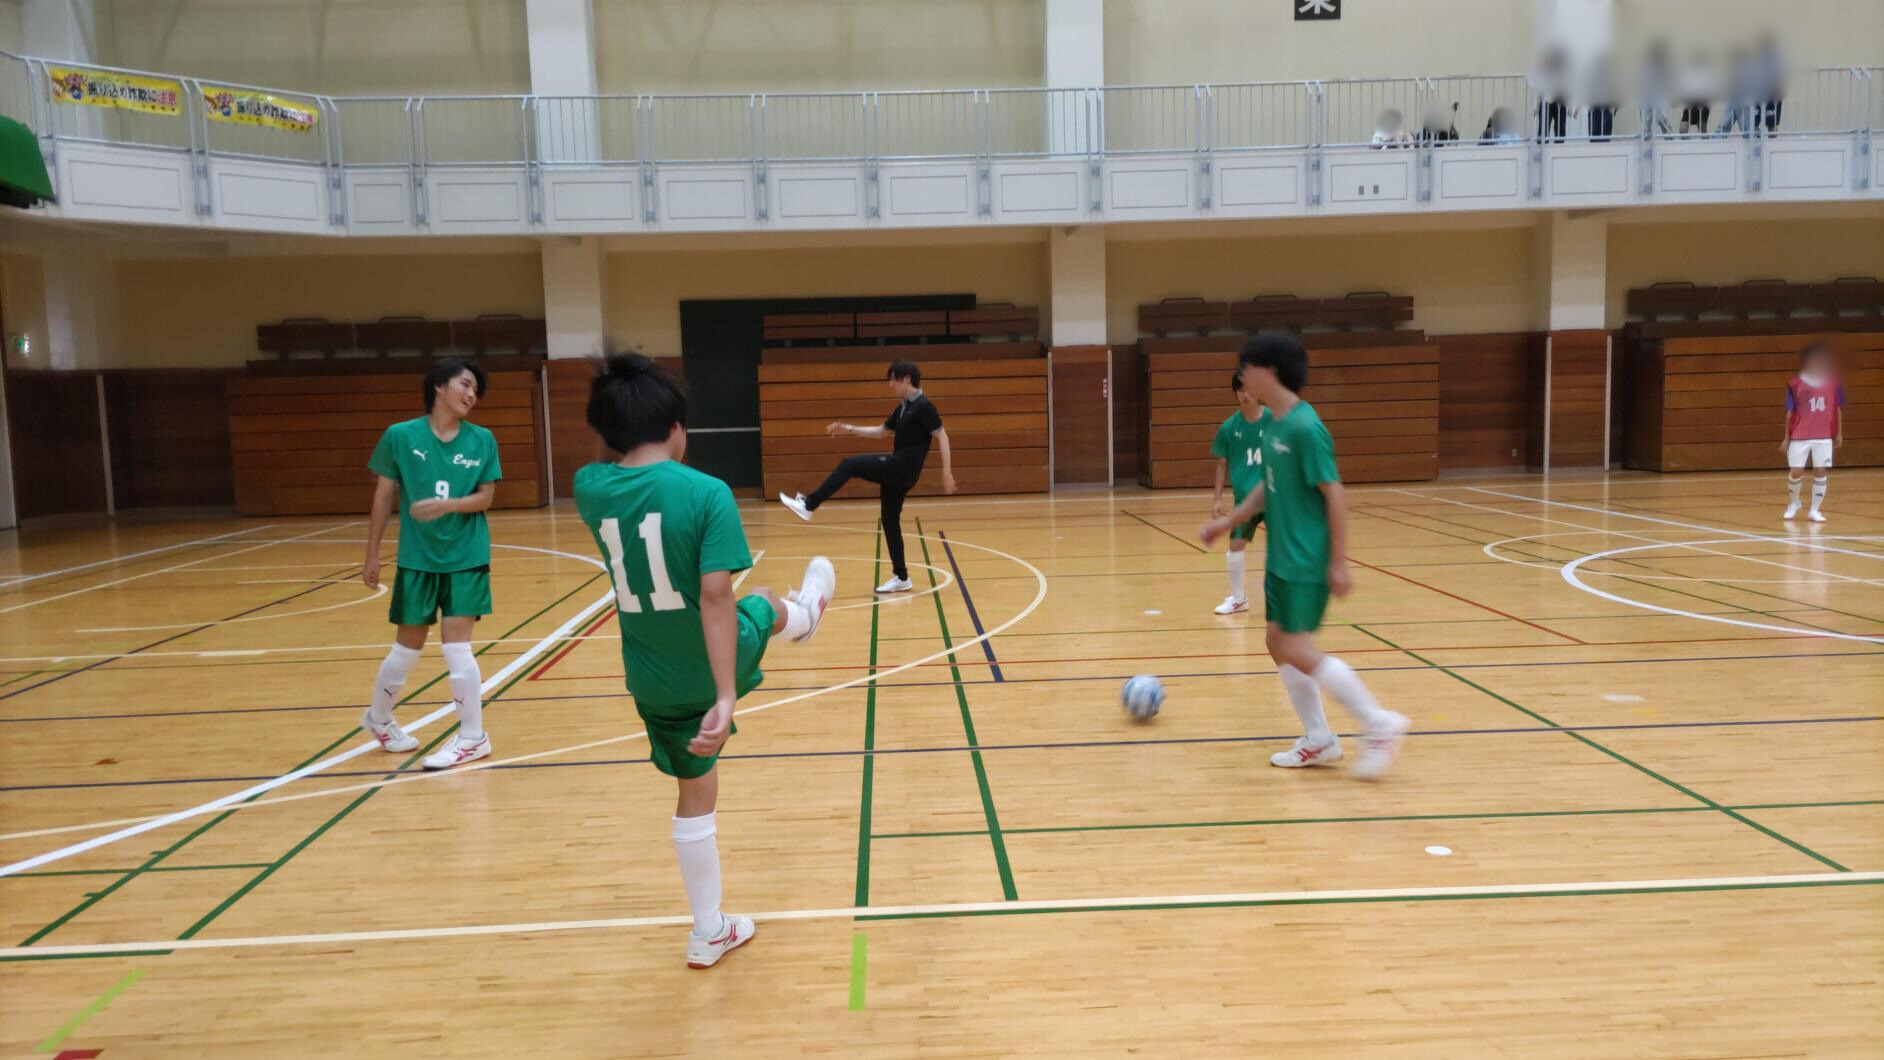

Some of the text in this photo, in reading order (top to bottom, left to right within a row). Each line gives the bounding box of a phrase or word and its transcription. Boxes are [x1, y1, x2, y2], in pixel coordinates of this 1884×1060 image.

[1808, 396, 1826, 412] 14
[1246, 447, 1263, 466] 14
[434, 480, 450, 501] 9
[599, 512, 686, 613] 11
